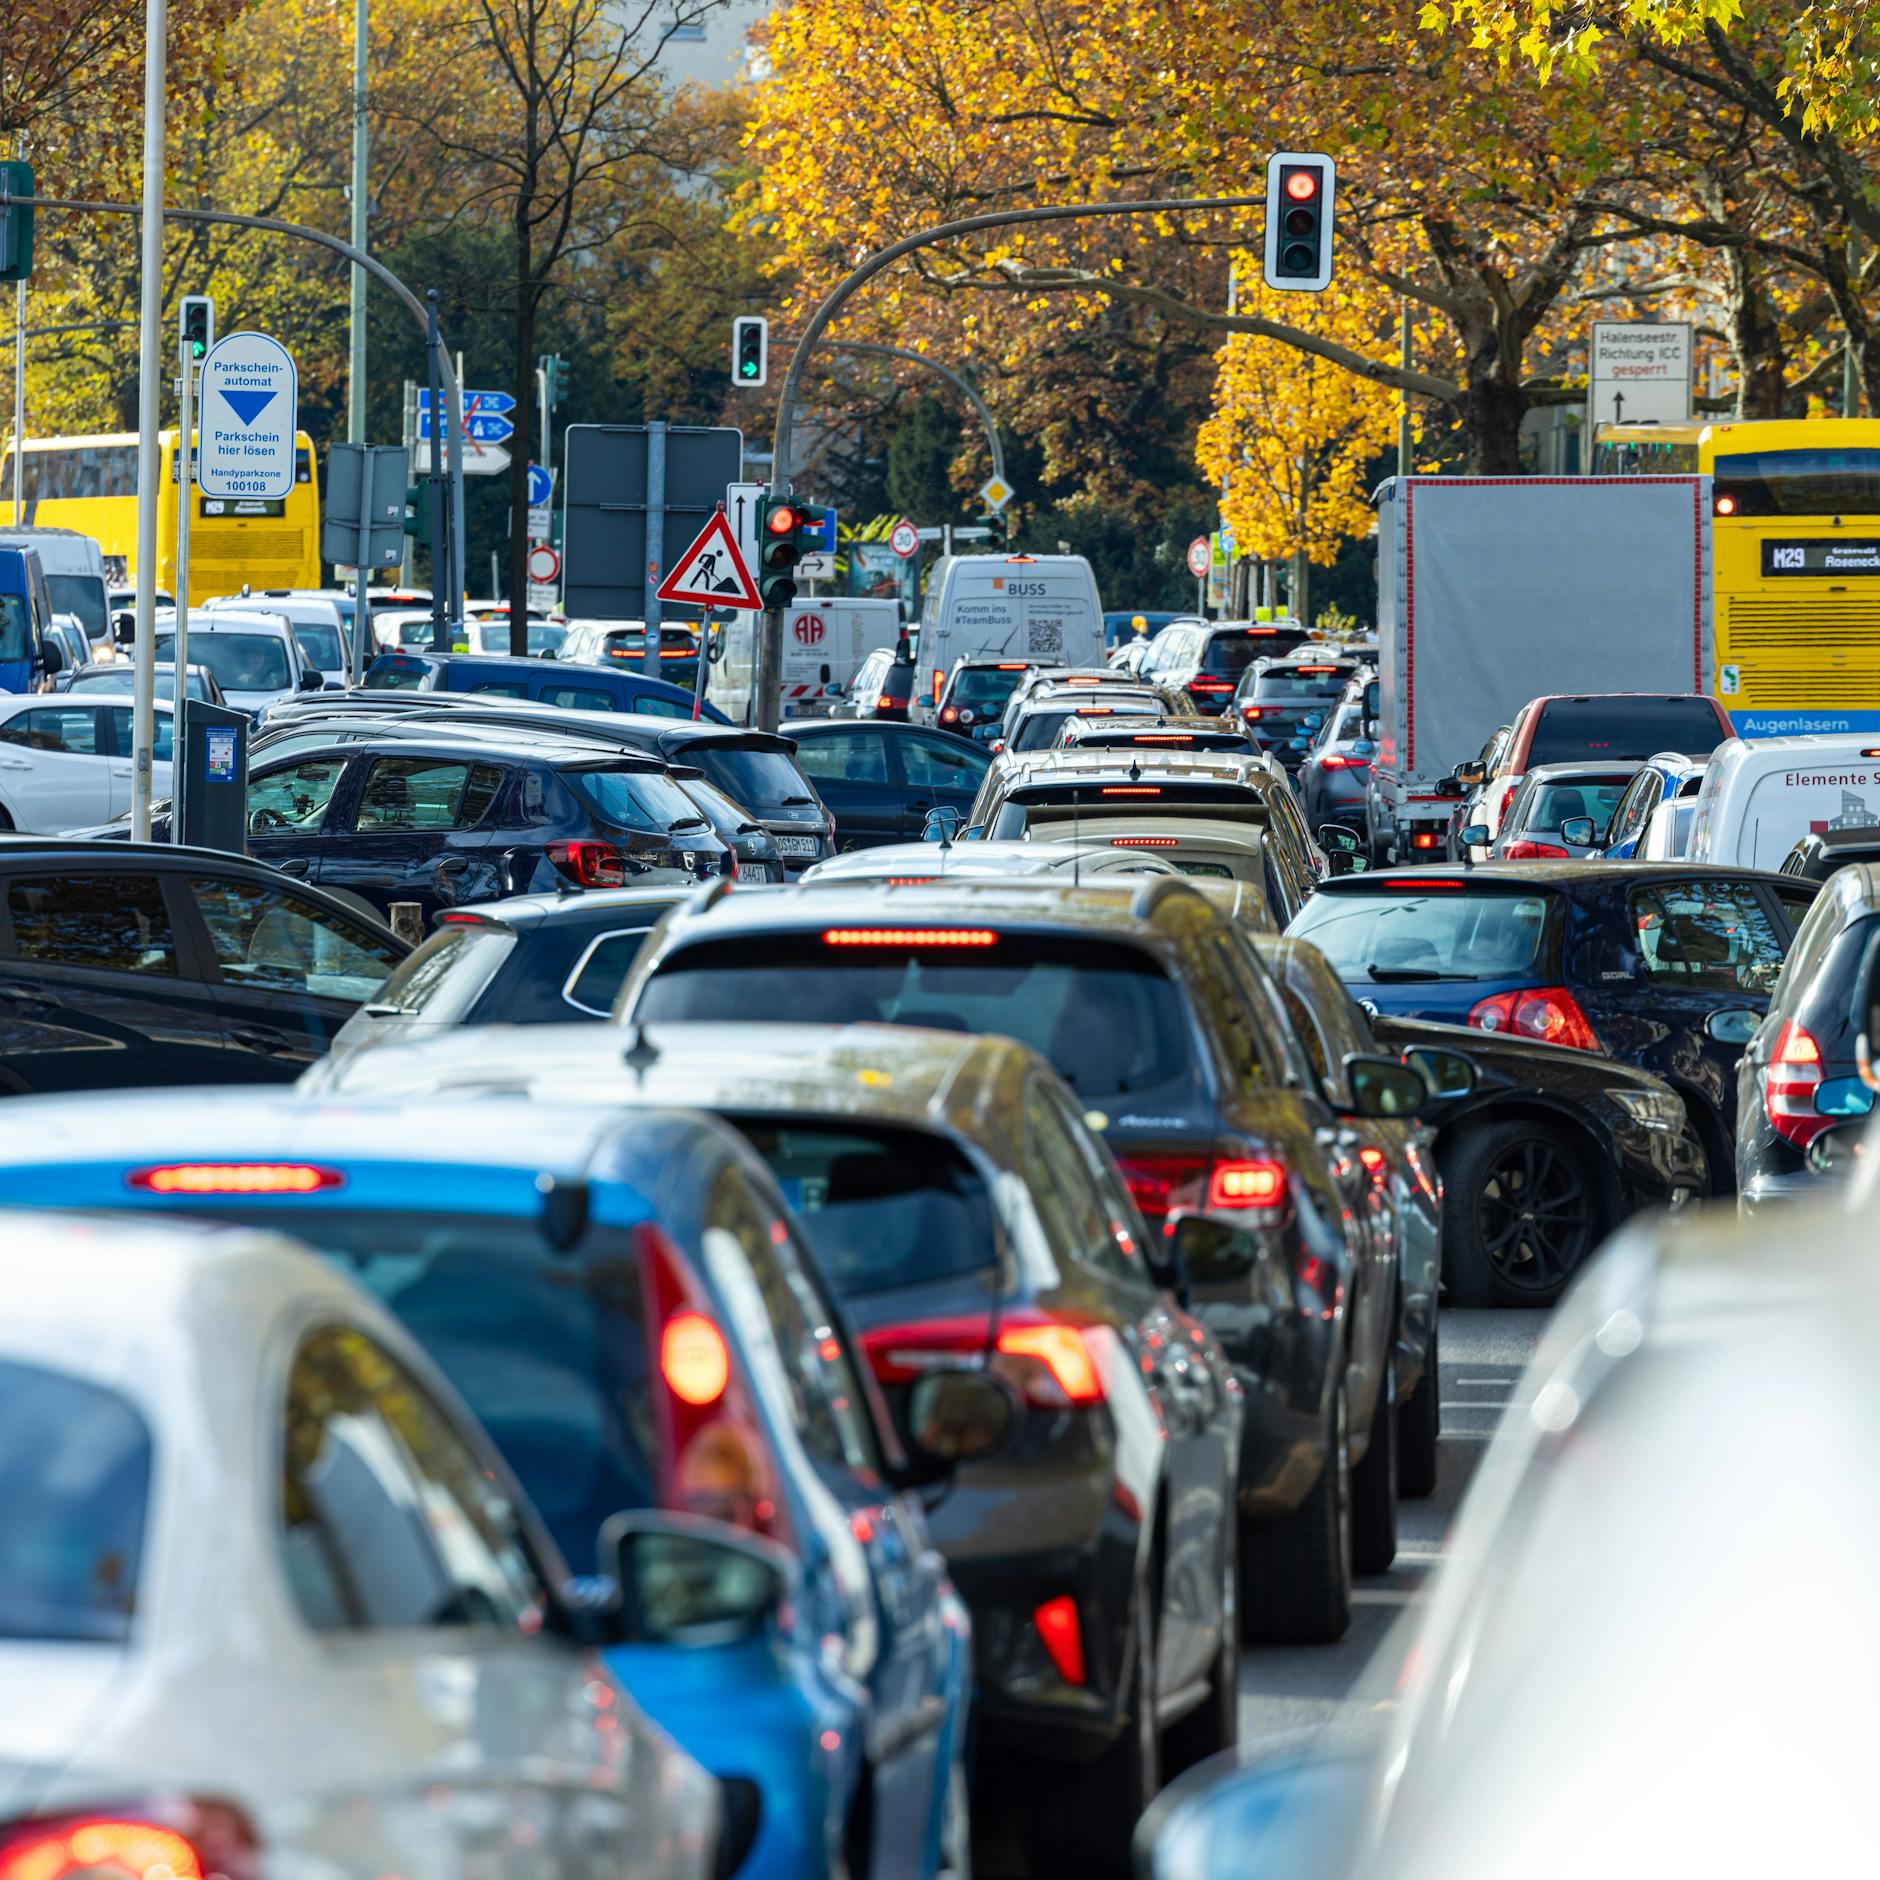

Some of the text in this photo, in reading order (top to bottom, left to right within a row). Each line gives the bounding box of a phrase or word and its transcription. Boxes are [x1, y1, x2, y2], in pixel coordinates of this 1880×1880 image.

[1600, 331, 1679, 344] Halenseestr.
[1600, 346, 1681, 362] Richtung ICC
[214, 361, 283, 373] Parkschein-
[1611, 364, 1668, 377] gesperrt
[224, 376, 272, 387] automat
[214, 431, 280, 442] Parkschein
[218, 445, 276, 456] hier lösen
[211, 468, 281, 479] Handyparkzone
[225, 481, 266, 492] 100108
[895, 532, 912, 547] 30
[1773, 547, 1805, 568] M29
[1008, 583, 1046, 596] BUSS
[957, 604, 1007, 614] Komm ins
[955, 615, 1012, 625] #TeamBuss
[1744, 718, 1849, 733] Augenlasern
[1786, 773, 1867, 786] Elemente
